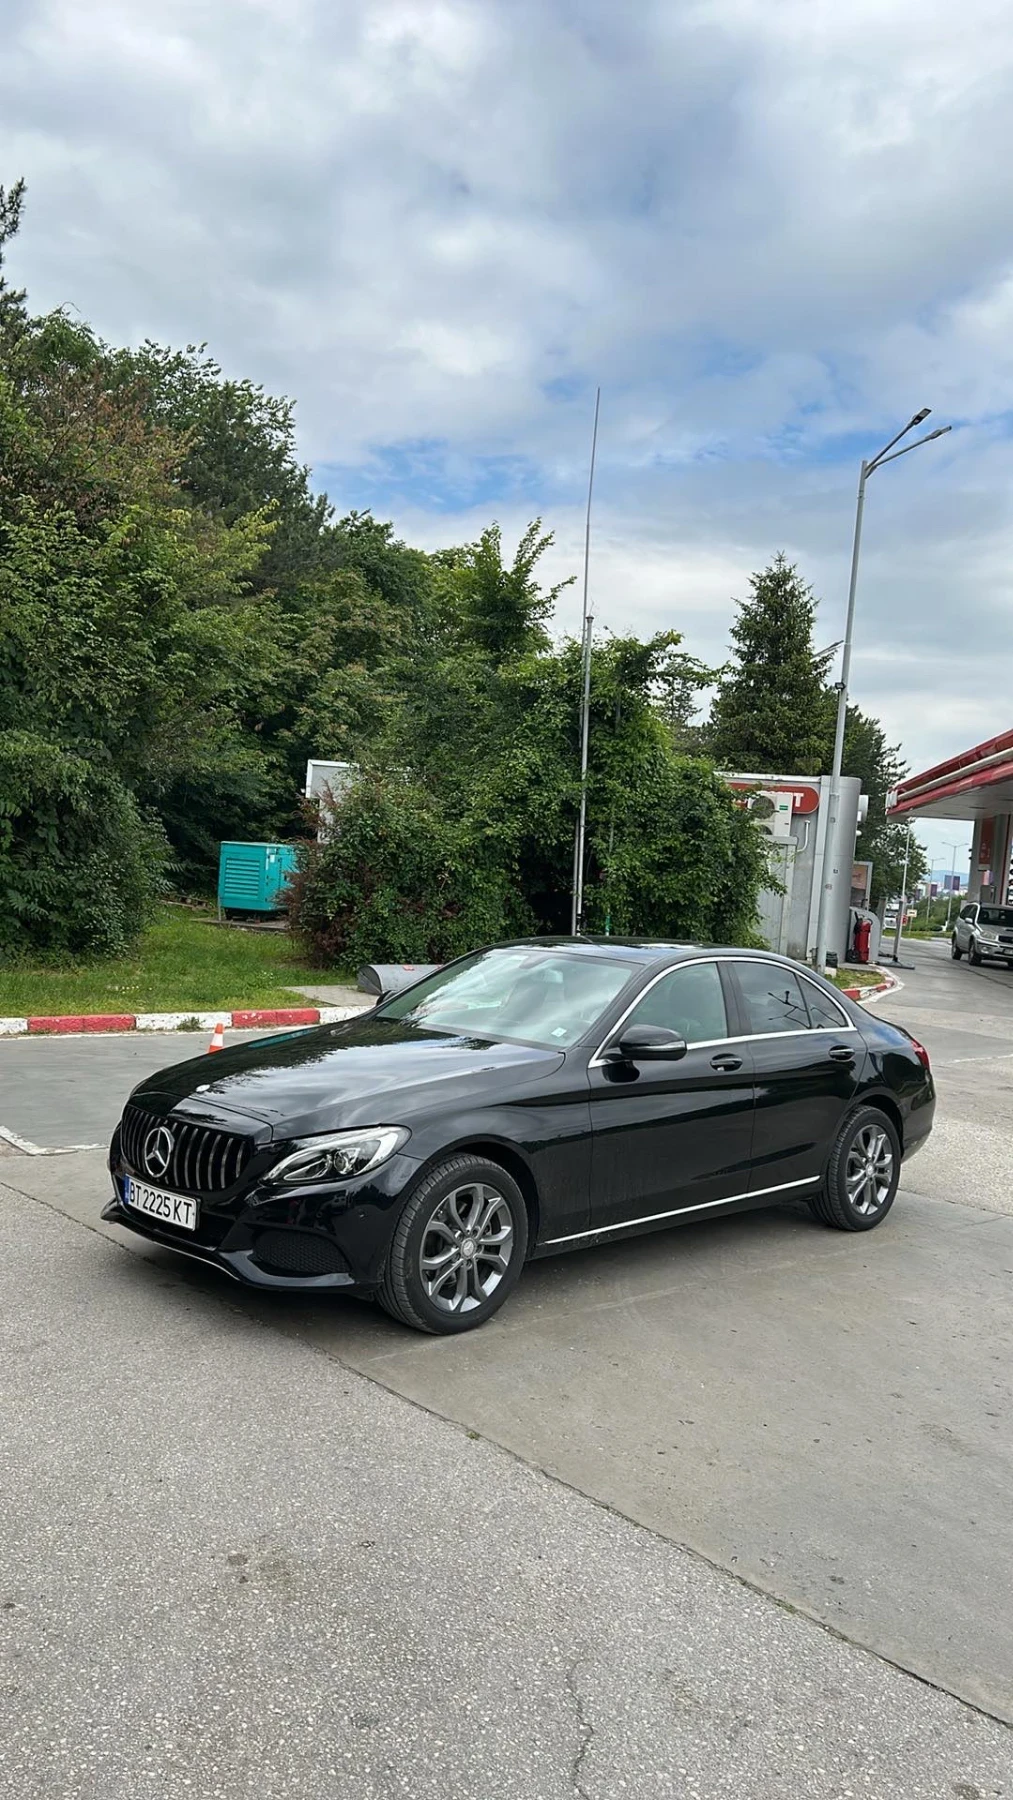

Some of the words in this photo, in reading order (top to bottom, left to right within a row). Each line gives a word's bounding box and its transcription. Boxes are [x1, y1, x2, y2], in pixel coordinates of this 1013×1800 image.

[130, 1181, 141, 1206] BT
[142, 1188, 171, 1218] 2225
[173, 1199, 192, 1224] KT
